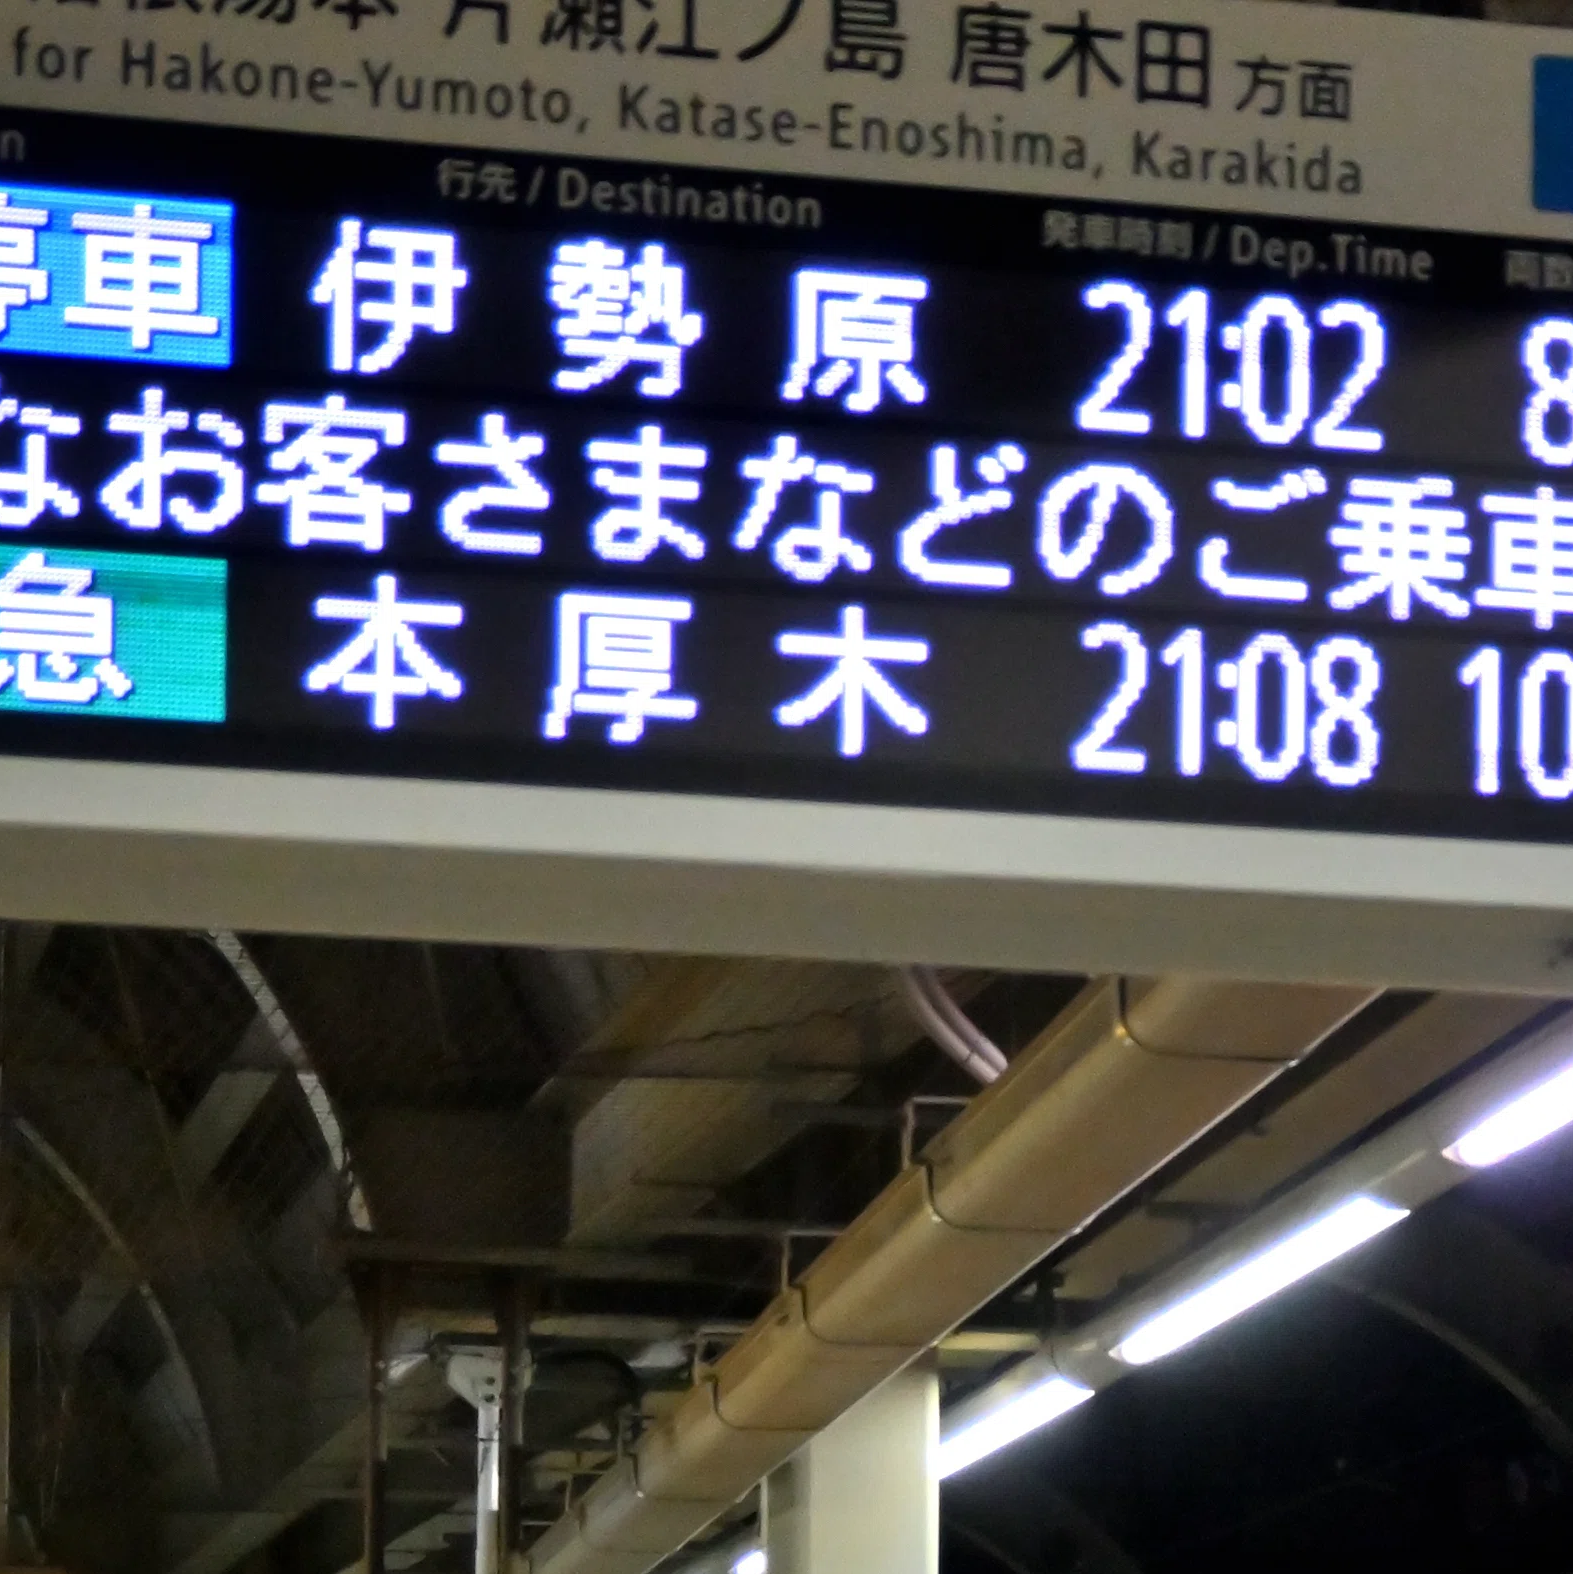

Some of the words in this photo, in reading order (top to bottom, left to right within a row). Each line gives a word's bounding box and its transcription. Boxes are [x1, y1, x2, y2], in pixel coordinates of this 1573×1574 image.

[12, 26, 95, 83] for
[121, 37, 589, 135] Hakone-Yumoto,
[620, 83, 1106, 177] Katase-Enoshima,
[1132, 131, 1365, 197] Karakida
[951, 3, 1213, 108] 唐木田
[1235, 57, 1355, 122] 方面
[557, 168, 824, 230] Destination
[310, 217, 931, 413] 伊勢原
[1077, 281, 1386, 452] 21:02
[305, 574, 931, 756] 本厚木
[1072, 622, 1384, 788] 21:08
